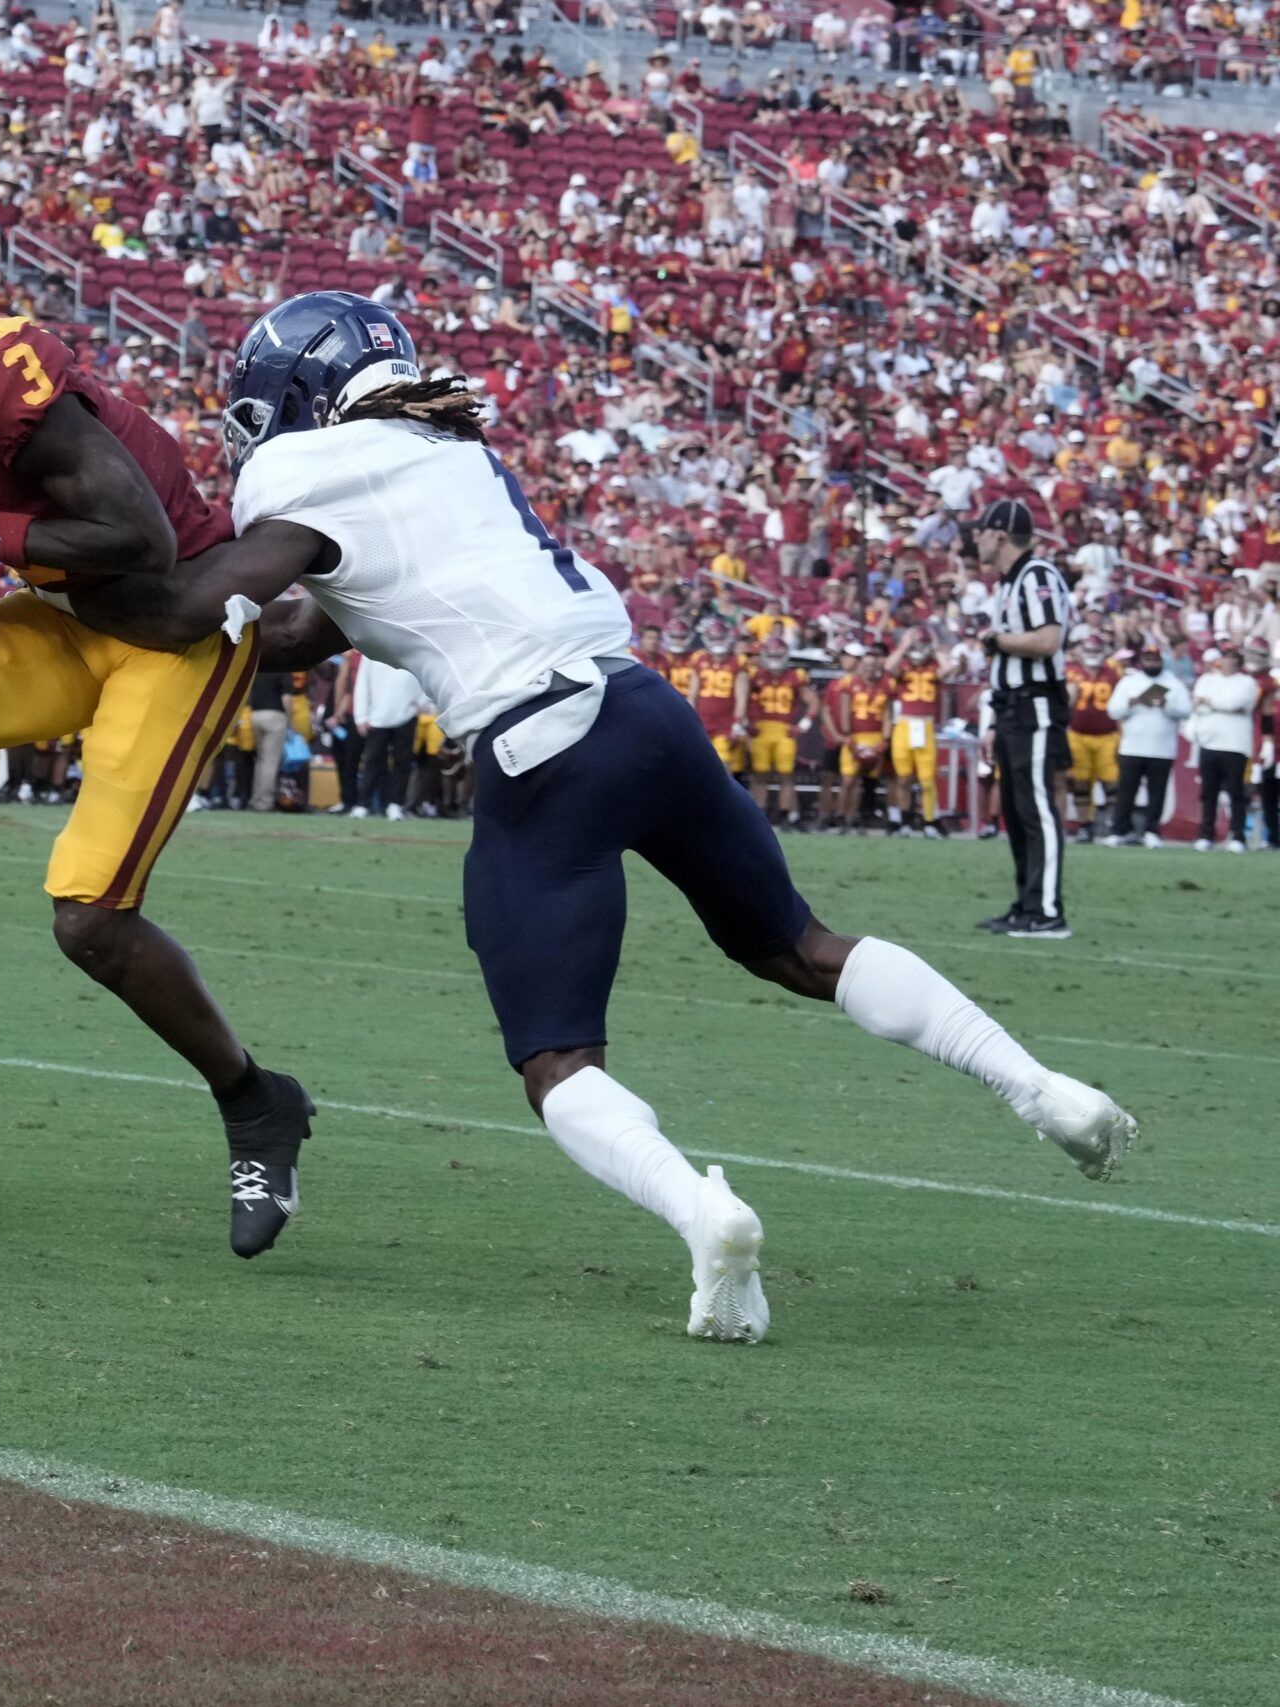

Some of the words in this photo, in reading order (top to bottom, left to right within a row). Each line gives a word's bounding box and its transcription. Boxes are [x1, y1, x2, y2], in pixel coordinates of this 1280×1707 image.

[2, 342, 55, 406] 3
[391, 363, 417, 378] OWLS
[480, 448, 593, 593] 1
